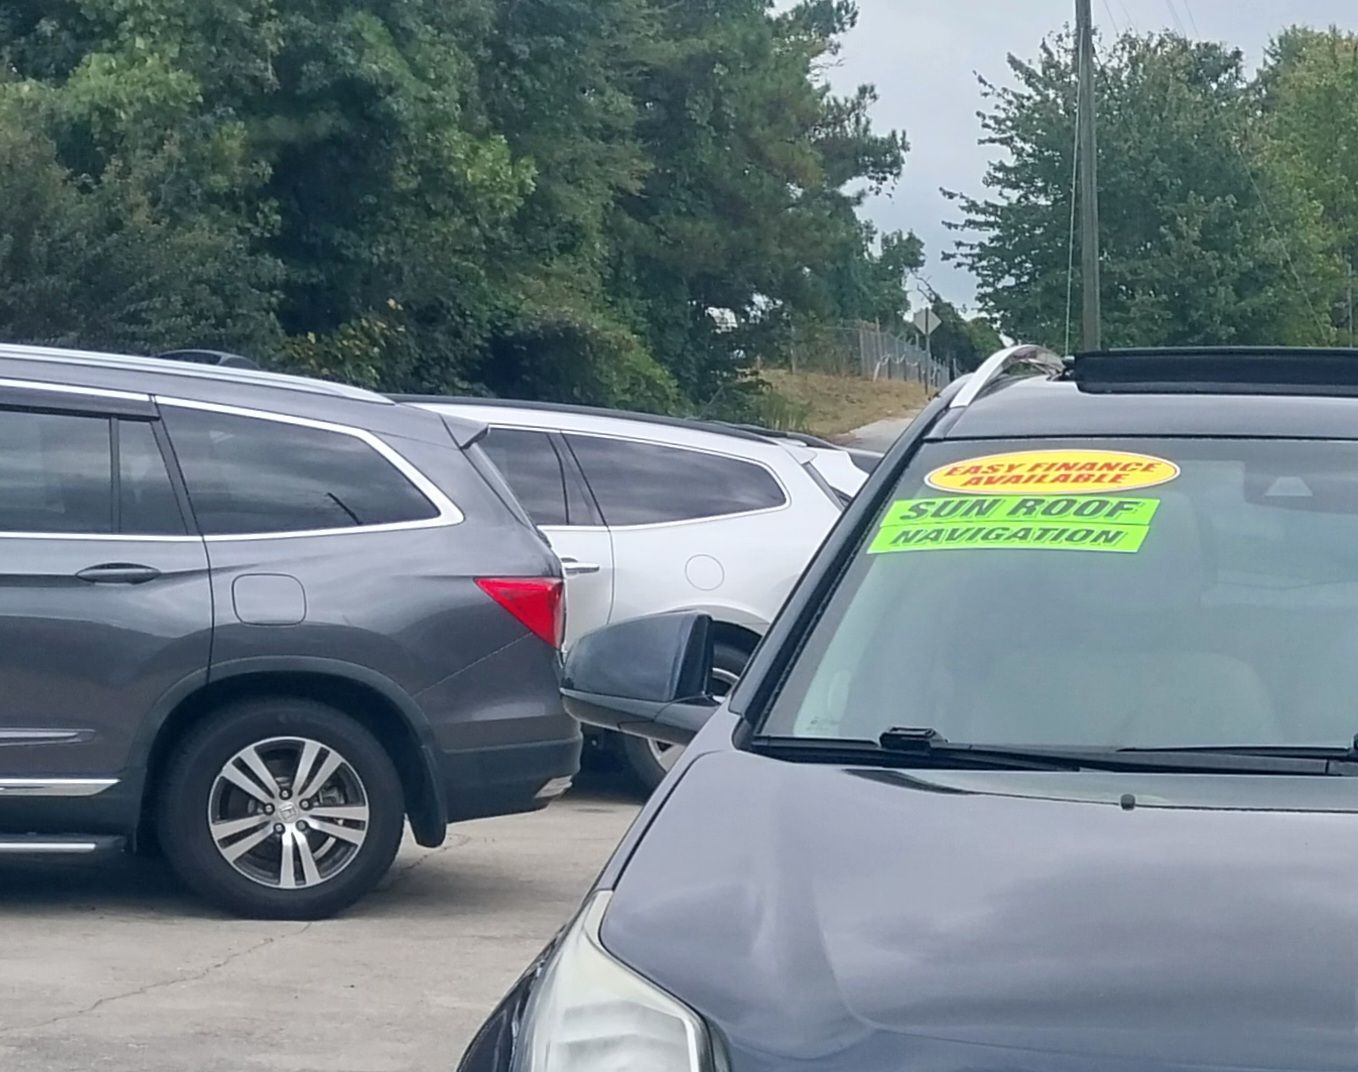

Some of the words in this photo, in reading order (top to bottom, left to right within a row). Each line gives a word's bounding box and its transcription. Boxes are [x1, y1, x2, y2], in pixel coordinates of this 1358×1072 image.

[944, 463, 1024, 476] EASY
[1027, 461, 1161, 473] FINANCE
[960, 473, 1128, 486] AVAILABLE
[900, 498, 1003, 520] SUN
[1006, 498, 1141, 519] ROOF
[890, 526, 1127, 546] NAVIGATION
